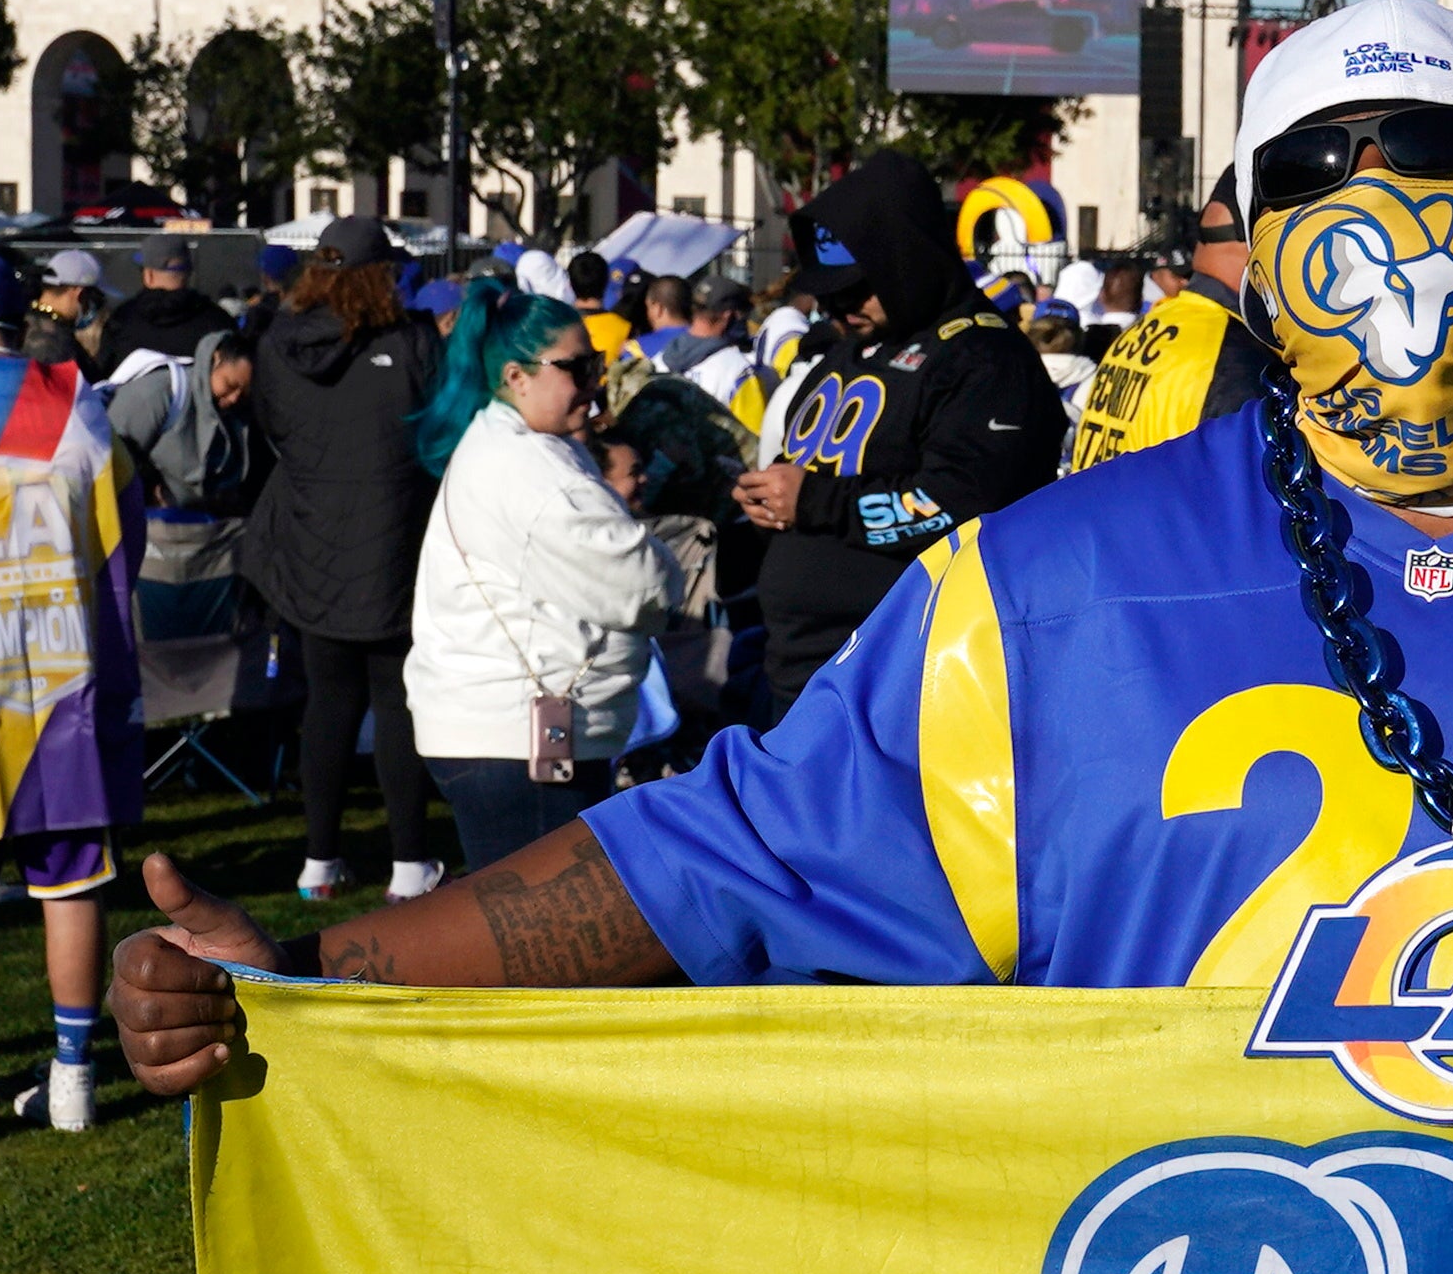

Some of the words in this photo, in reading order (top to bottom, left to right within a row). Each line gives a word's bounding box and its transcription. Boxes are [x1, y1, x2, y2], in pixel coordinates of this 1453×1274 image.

[1343, 41, 1389, 57] LOS
[1344, 51, 1452, 71] ANGELES
[1345, 61, 1414, 78] RAMS
[1111, 318, 1179, 367] CSC
[1087, 363, 1153, 423] ECURITY
[784, 371, 887, 477] 99
[1360, 434, 1447, 477] MS
[1413, 567, 1451, 590] NFL
